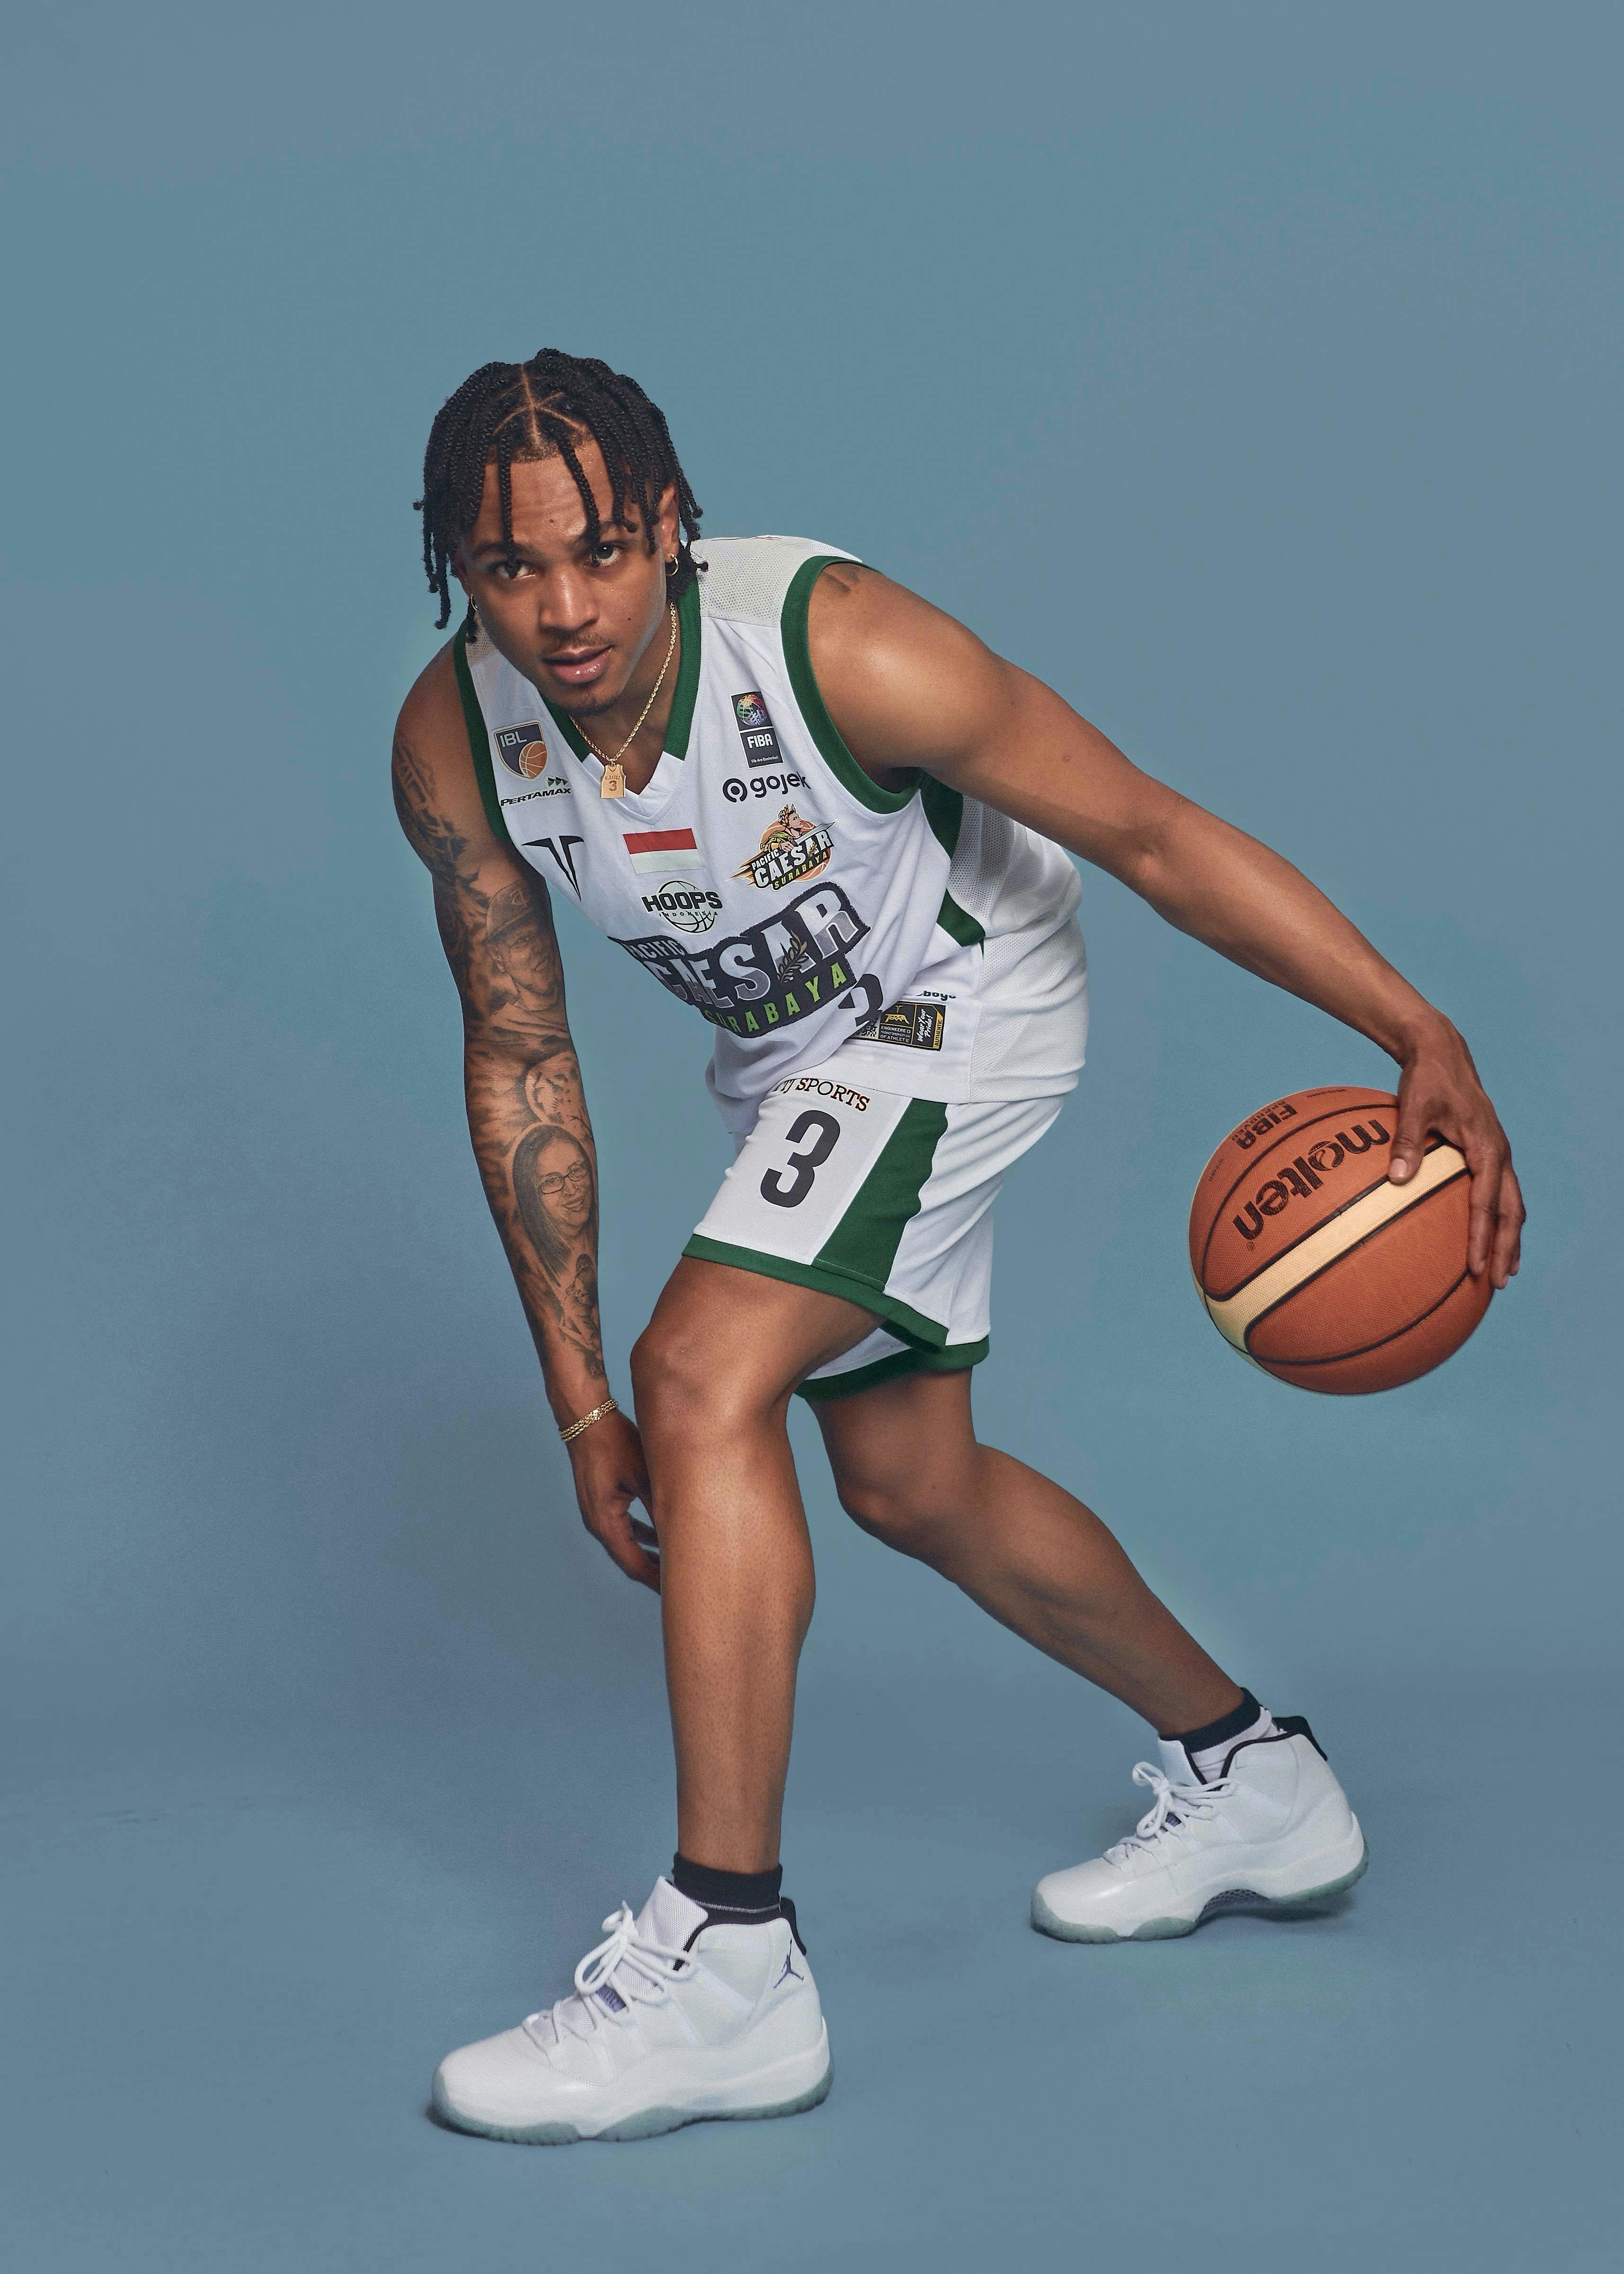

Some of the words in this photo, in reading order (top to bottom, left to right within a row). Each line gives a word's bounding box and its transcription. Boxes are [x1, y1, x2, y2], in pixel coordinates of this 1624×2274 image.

[500, 731, 527, 747] IBL
[747, 733, 773, 748] FIBA
[501, 788, 571, 806] PERTAMAX
[609, 780, 617, 791] 3
[750, 771, 811, 798] gojek
[751, 849, 779, 870] PACIFIC
[754, 830, 832, 887] CAESAR
[774, 852, 827, 888] SURABAYA
[641, 891, 723, 912] HOOPS
[643, 890, 859, 1008] CAESAR
[704, 961, 847, 1032] SURABAYA
[885, 1013, 909, 1024] TERRA
[795, 1078, 870, 1111] SPORTS
[1236, 1104, 1297, 1149] FIBA
[761, 1110, 840, 1208] 3
[1233, 1119, 1390, 1240] molten
